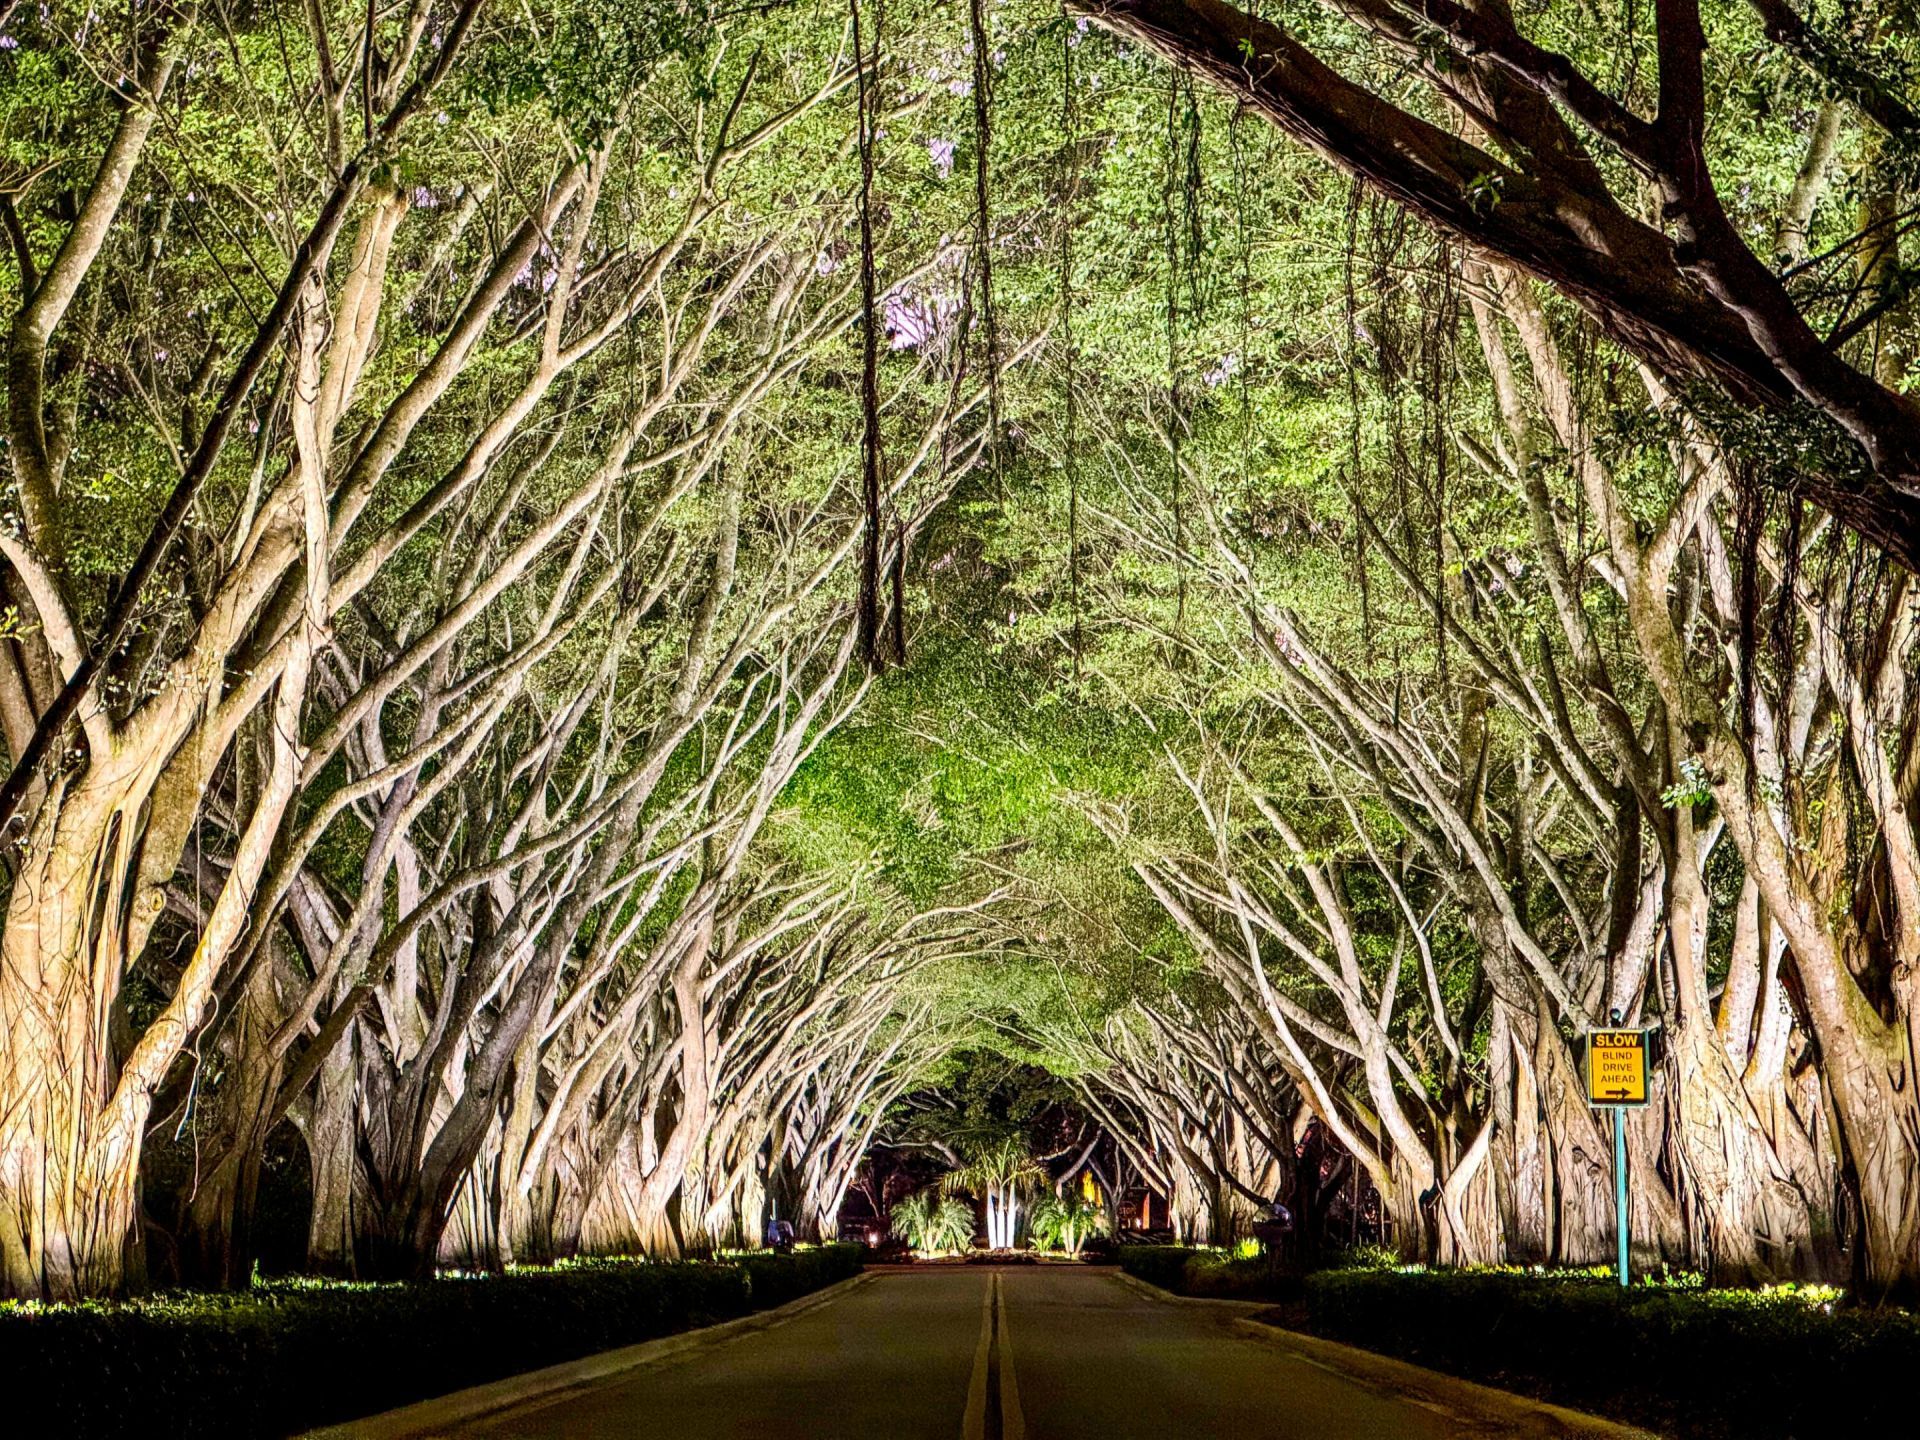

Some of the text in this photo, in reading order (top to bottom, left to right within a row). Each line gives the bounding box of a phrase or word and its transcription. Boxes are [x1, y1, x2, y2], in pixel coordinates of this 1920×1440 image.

[1596, 1035, 1637, 1046] SLOW
[1602, 1052, 1632, 1060] BLIND
[1603, 1063, 1632, 1071] DRIVE
[1600, 1075, 1635, 1083] AHEAD
